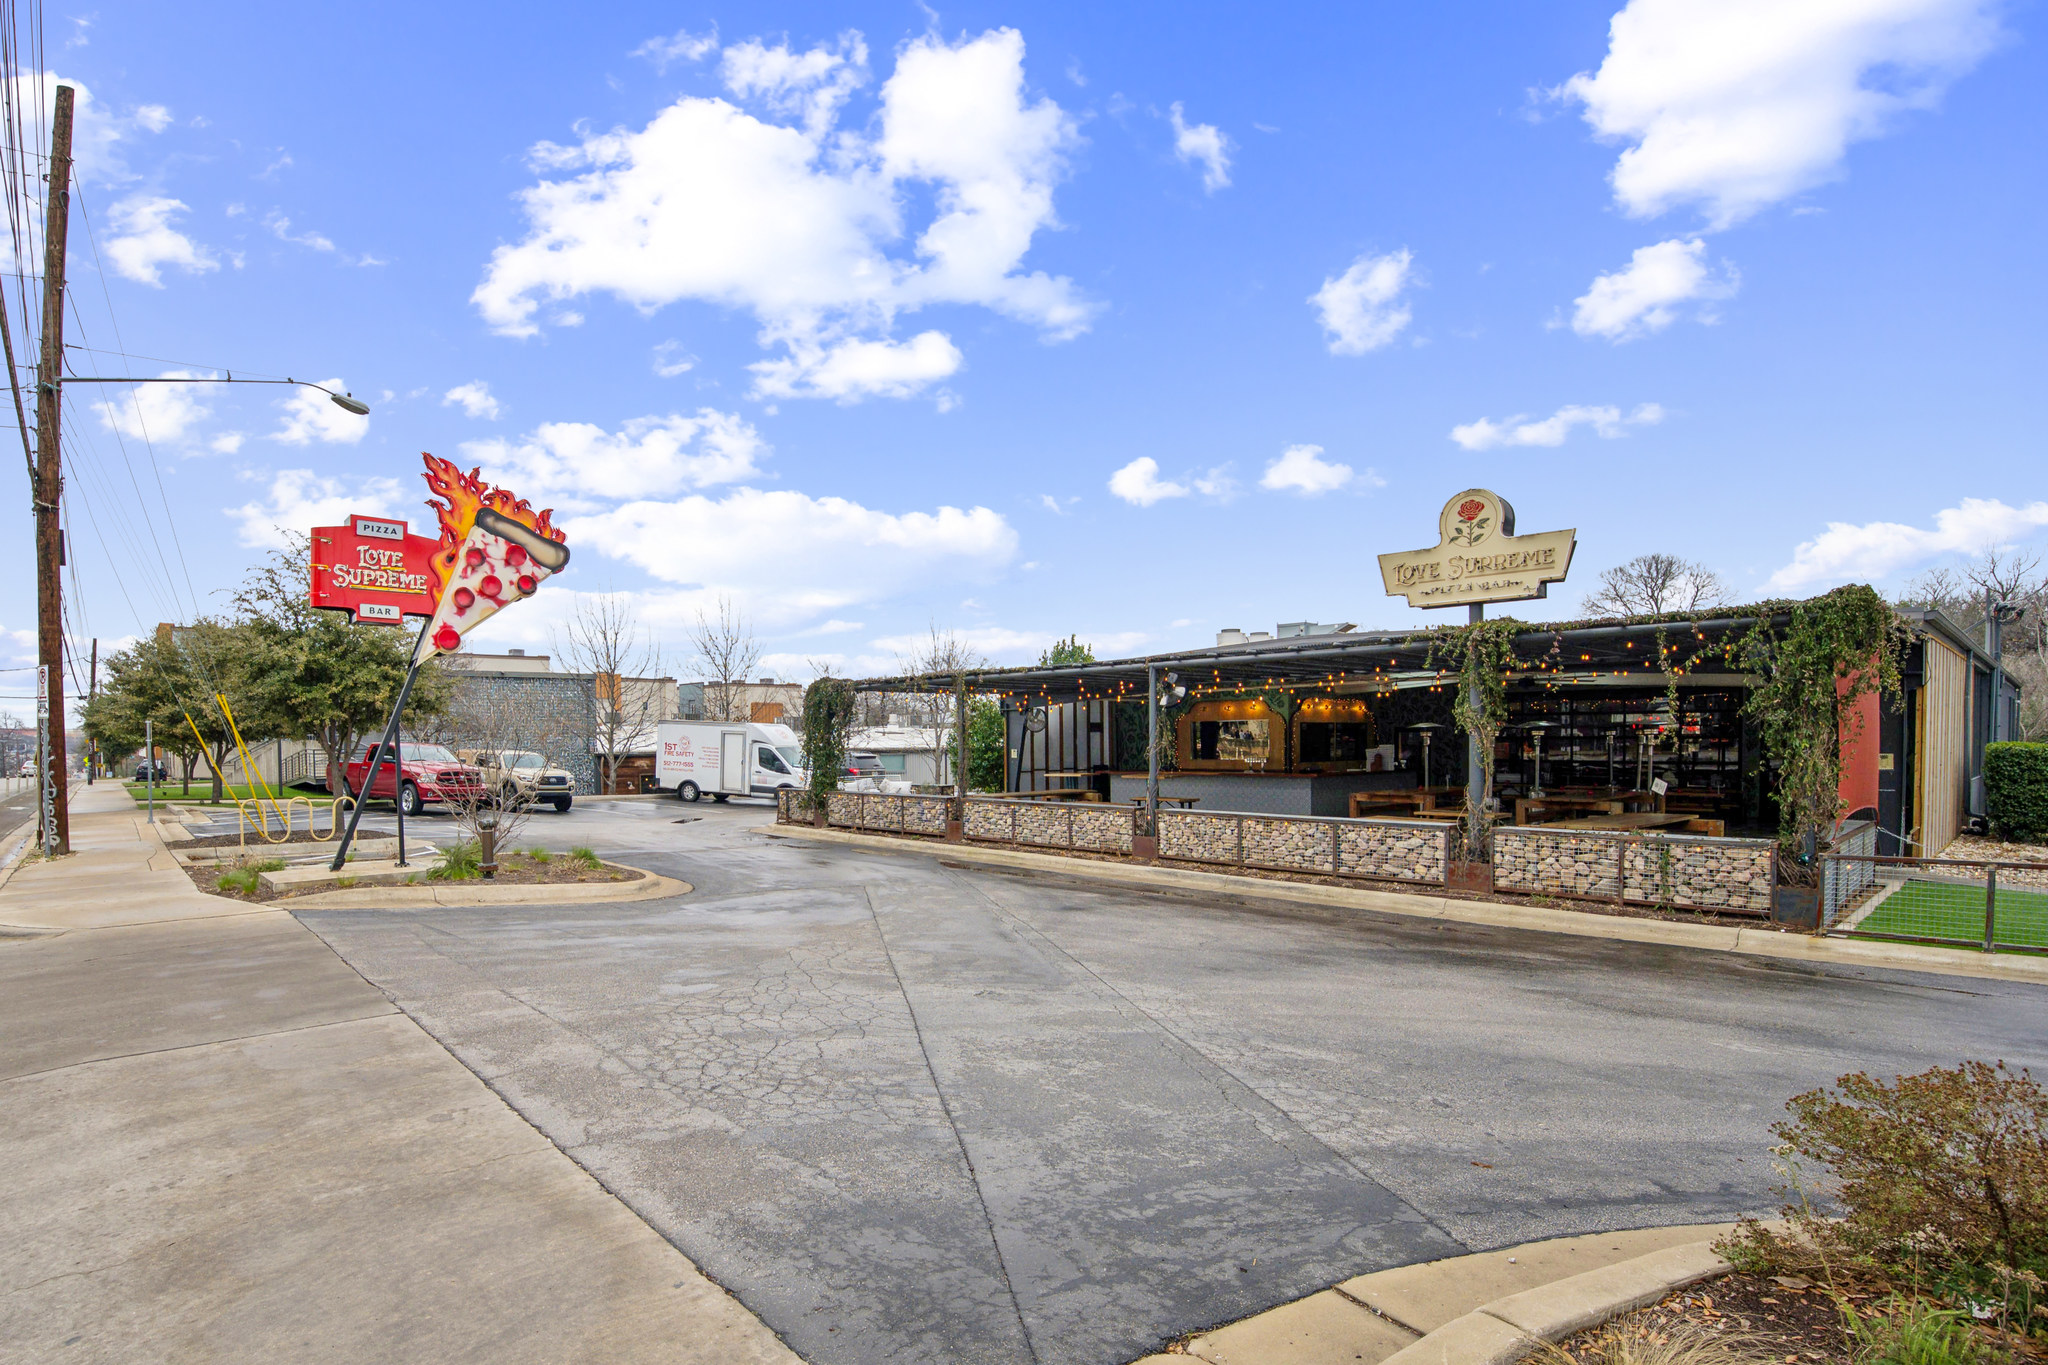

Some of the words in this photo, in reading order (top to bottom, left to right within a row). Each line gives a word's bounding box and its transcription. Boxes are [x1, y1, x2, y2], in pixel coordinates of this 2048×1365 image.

[363, 524, 398, 535] PIZZA
[356, 545, 404, 569] LOVE
[332, 564, 428, 590] SUPREME
[1393, 561, 1441, 586] LOVE
[368, 606, 392, 616] BAR
[664, 742, 677, 751] 1ST
